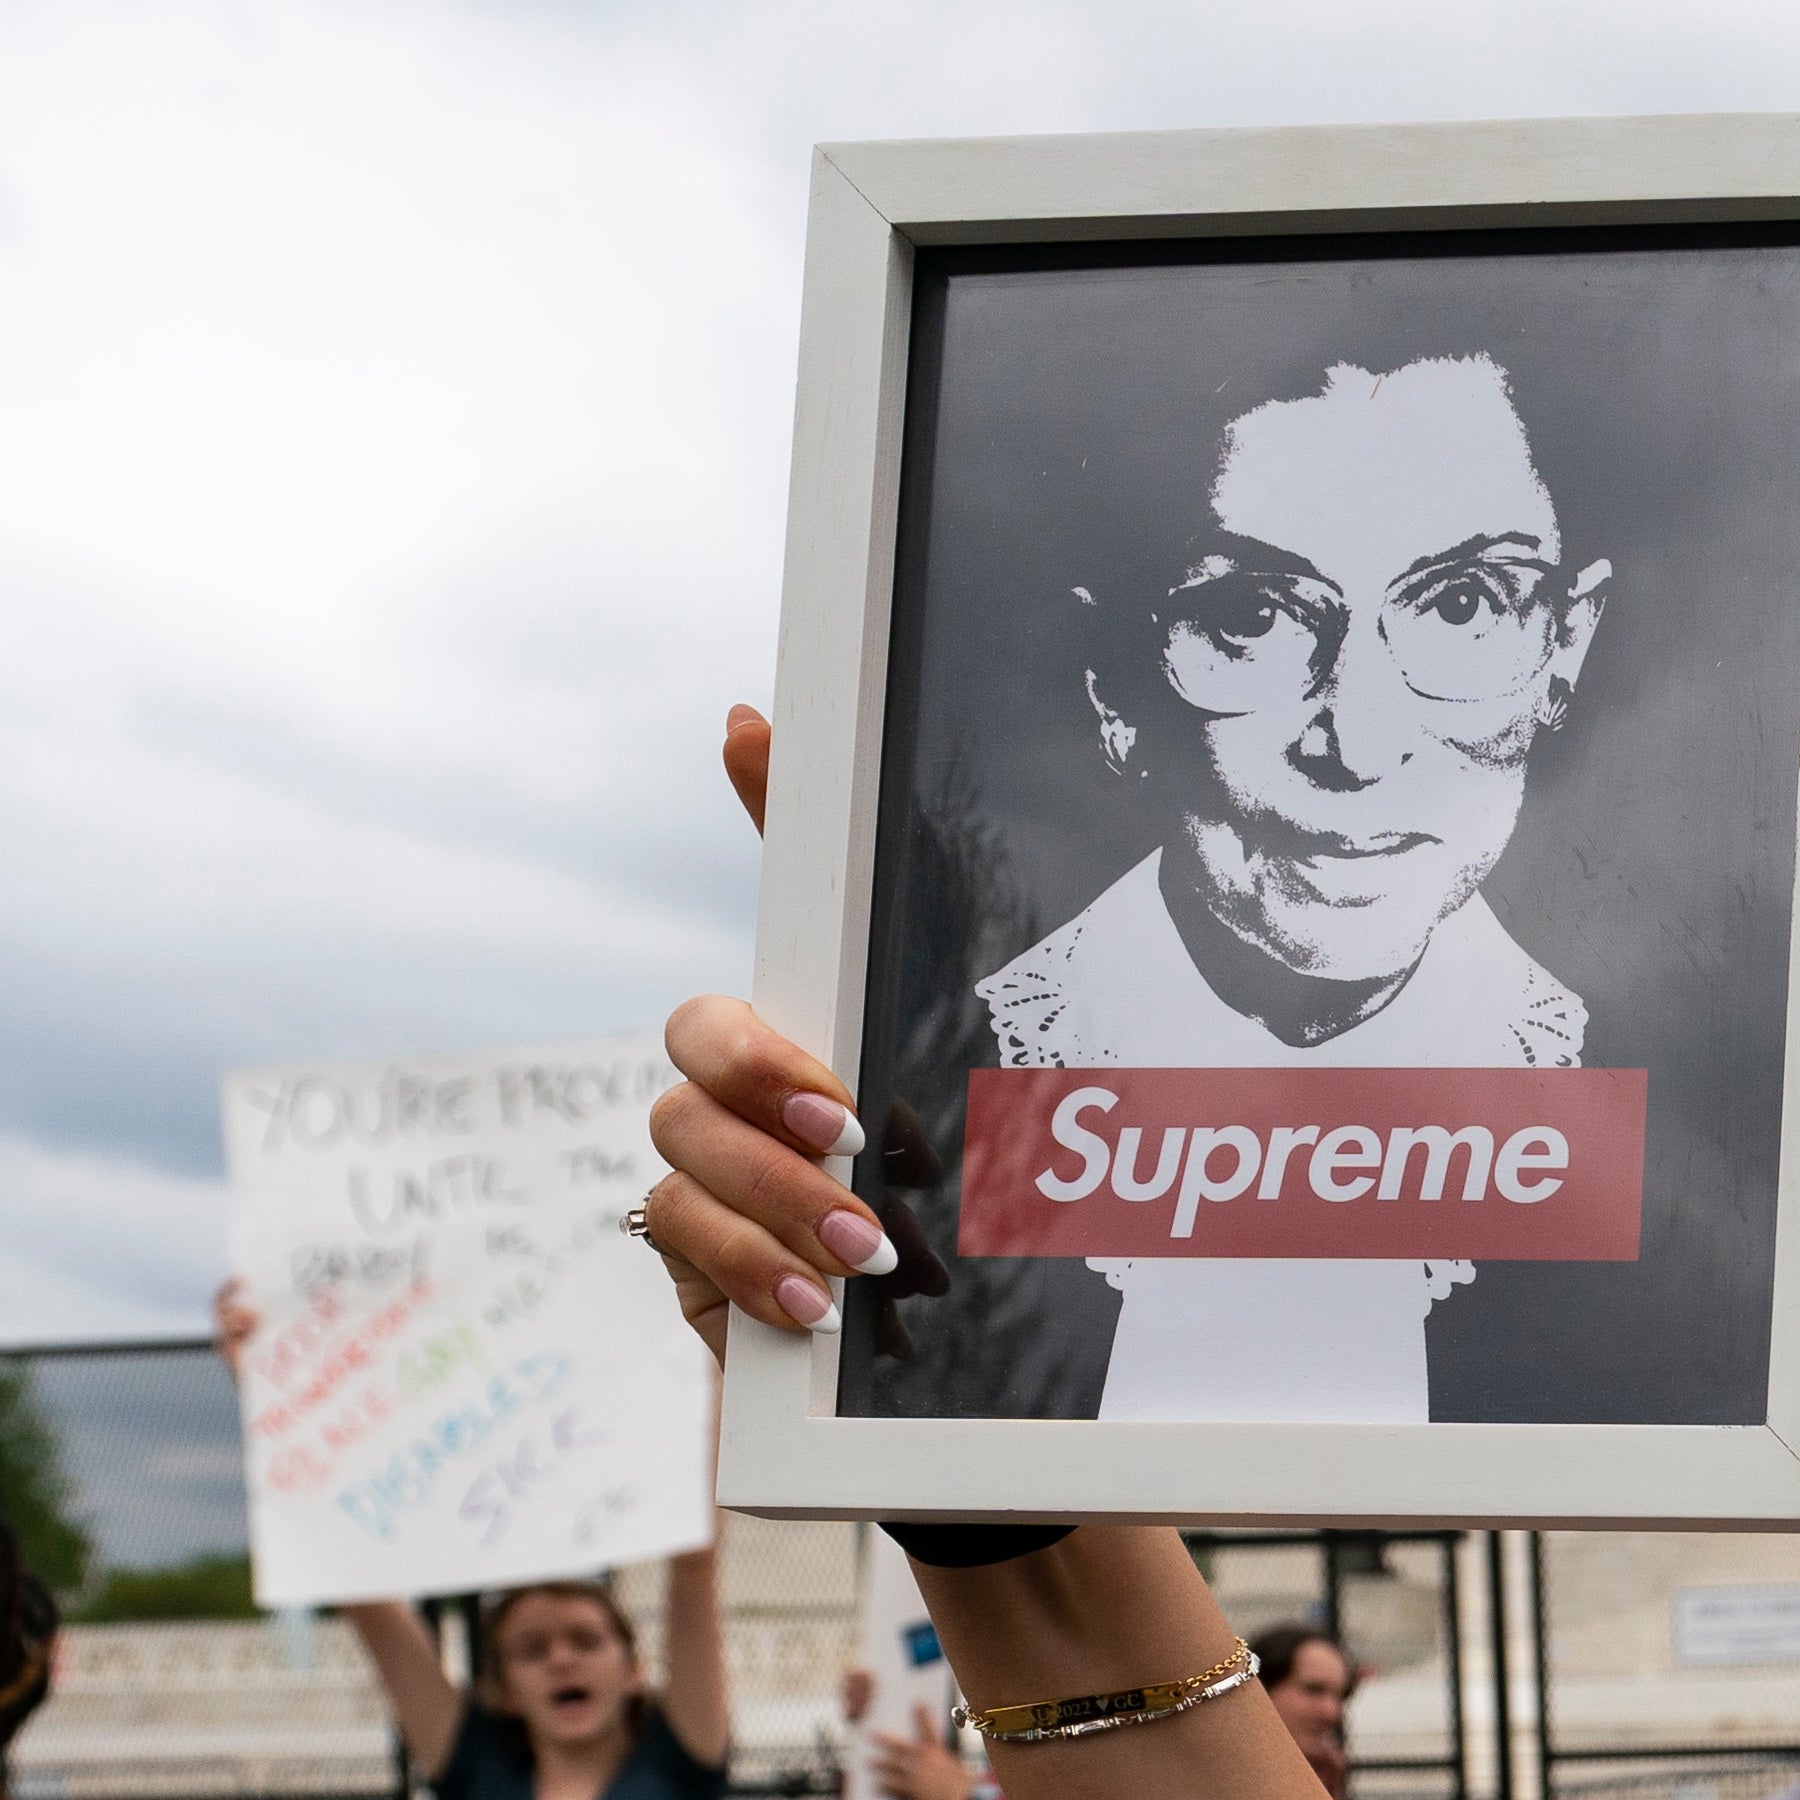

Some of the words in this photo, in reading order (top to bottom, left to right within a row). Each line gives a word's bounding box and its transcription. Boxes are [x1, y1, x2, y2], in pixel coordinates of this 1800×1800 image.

[1034, 1085, 1569, 1238] Supreme
[336, 1350, 573, 1543] DISABLED
[1057, 1701, 1091, 1719] 2022
[1114, 1693, 1140, 1710] GC
